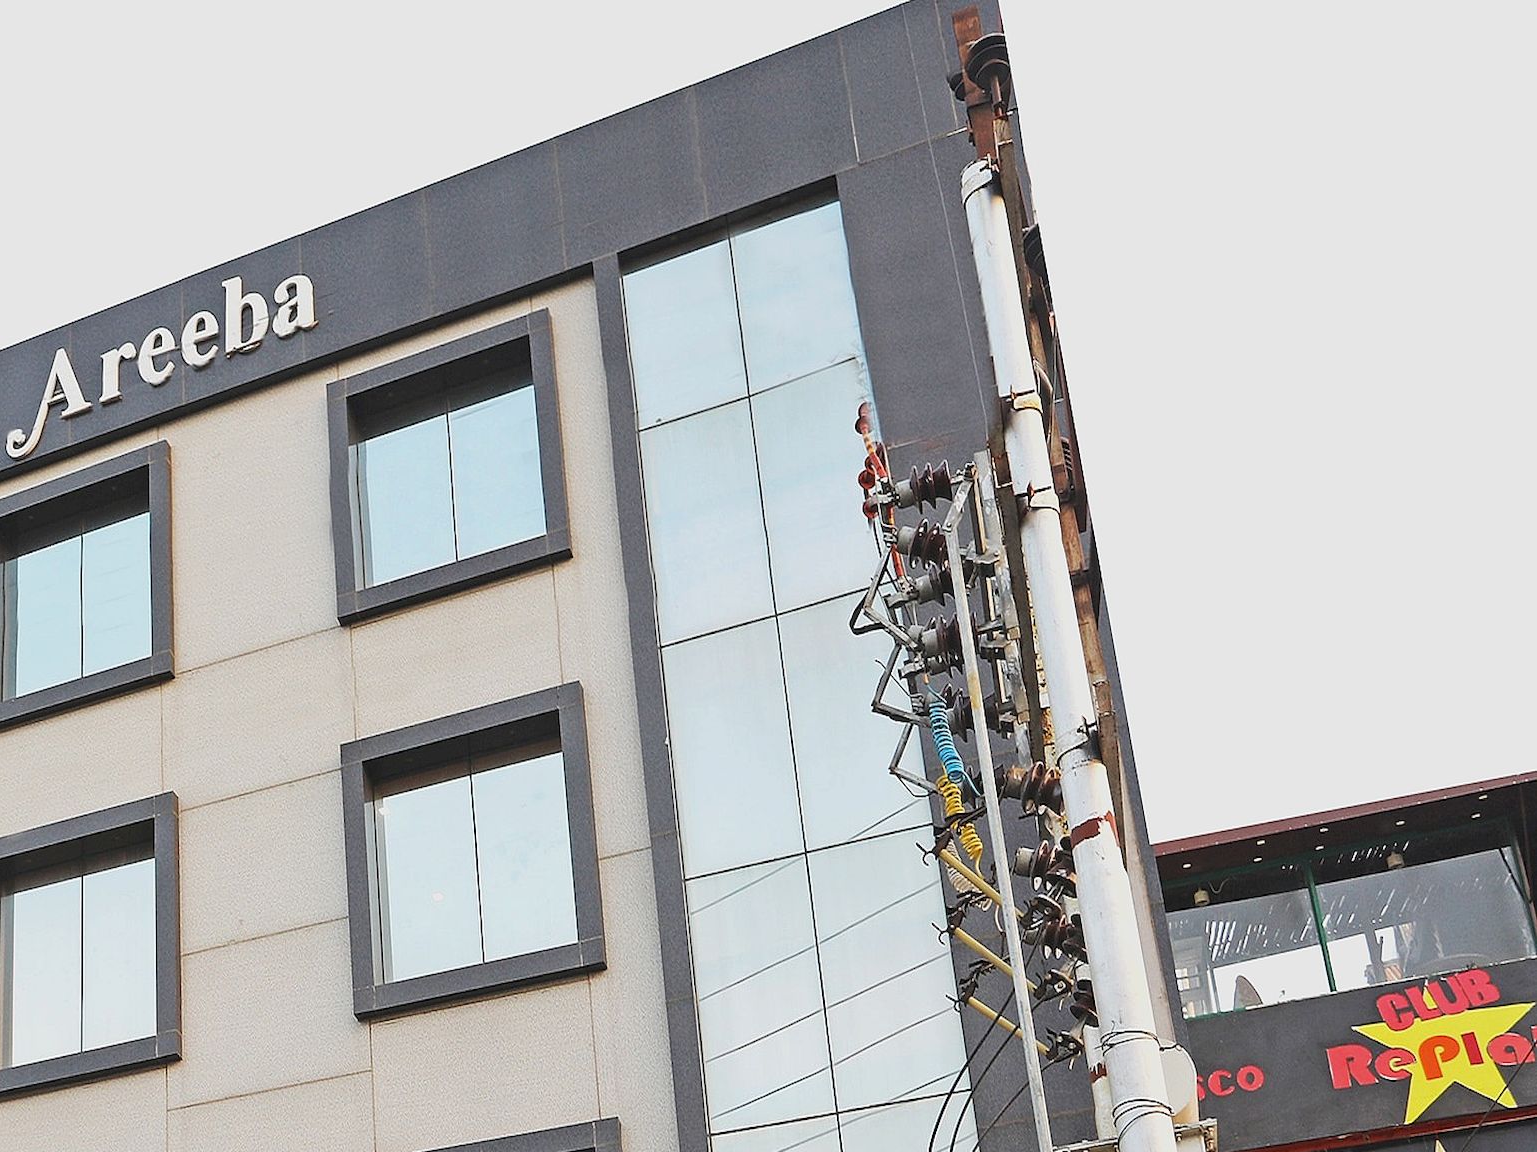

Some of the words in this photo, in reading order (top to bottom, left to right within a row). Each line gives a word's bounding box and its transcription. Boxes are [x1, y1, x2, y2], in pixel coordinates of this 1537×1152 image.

[5, 273, 319, 459] Areeba
[1376, 968, 1501, 1032] CLUB
[1326, 1025, 1537, 1091] RePla
